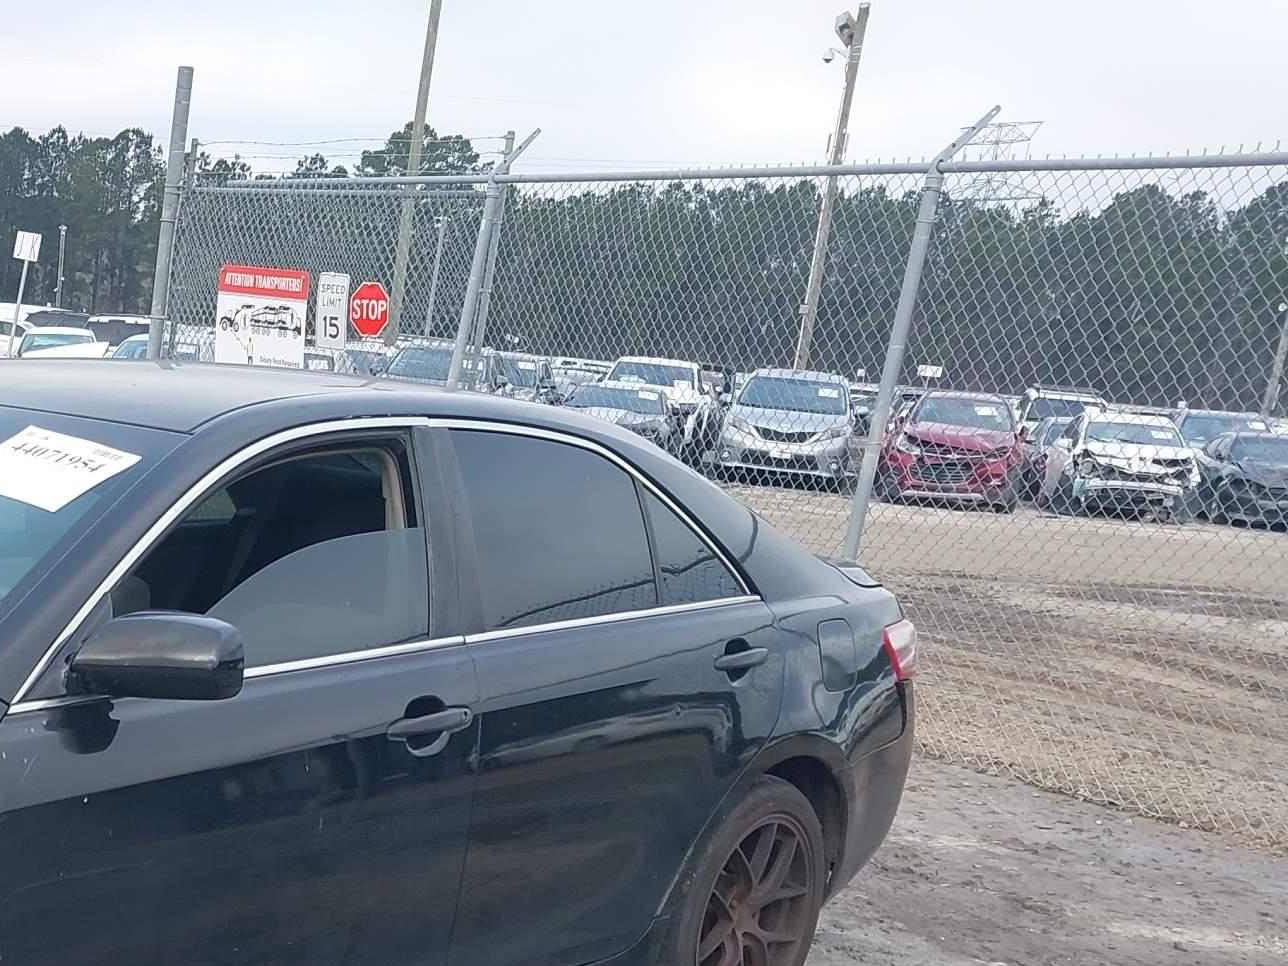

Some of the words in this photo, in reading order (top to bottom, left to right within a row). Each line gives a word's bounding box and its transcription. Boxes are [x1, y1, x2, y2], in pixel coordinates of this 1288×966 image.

[224, 271, 255, 288] ATTENTION
[255, 275, 304, 292] TRANSPORTERS!
[321, 283, 346, 295] SPEED
[322, 297, 342, 307] LIMIT
[352, 299, 387, 320] STOP
[323, 315, 340, 339] 15
[11, 443, 106, 472] 44071954
